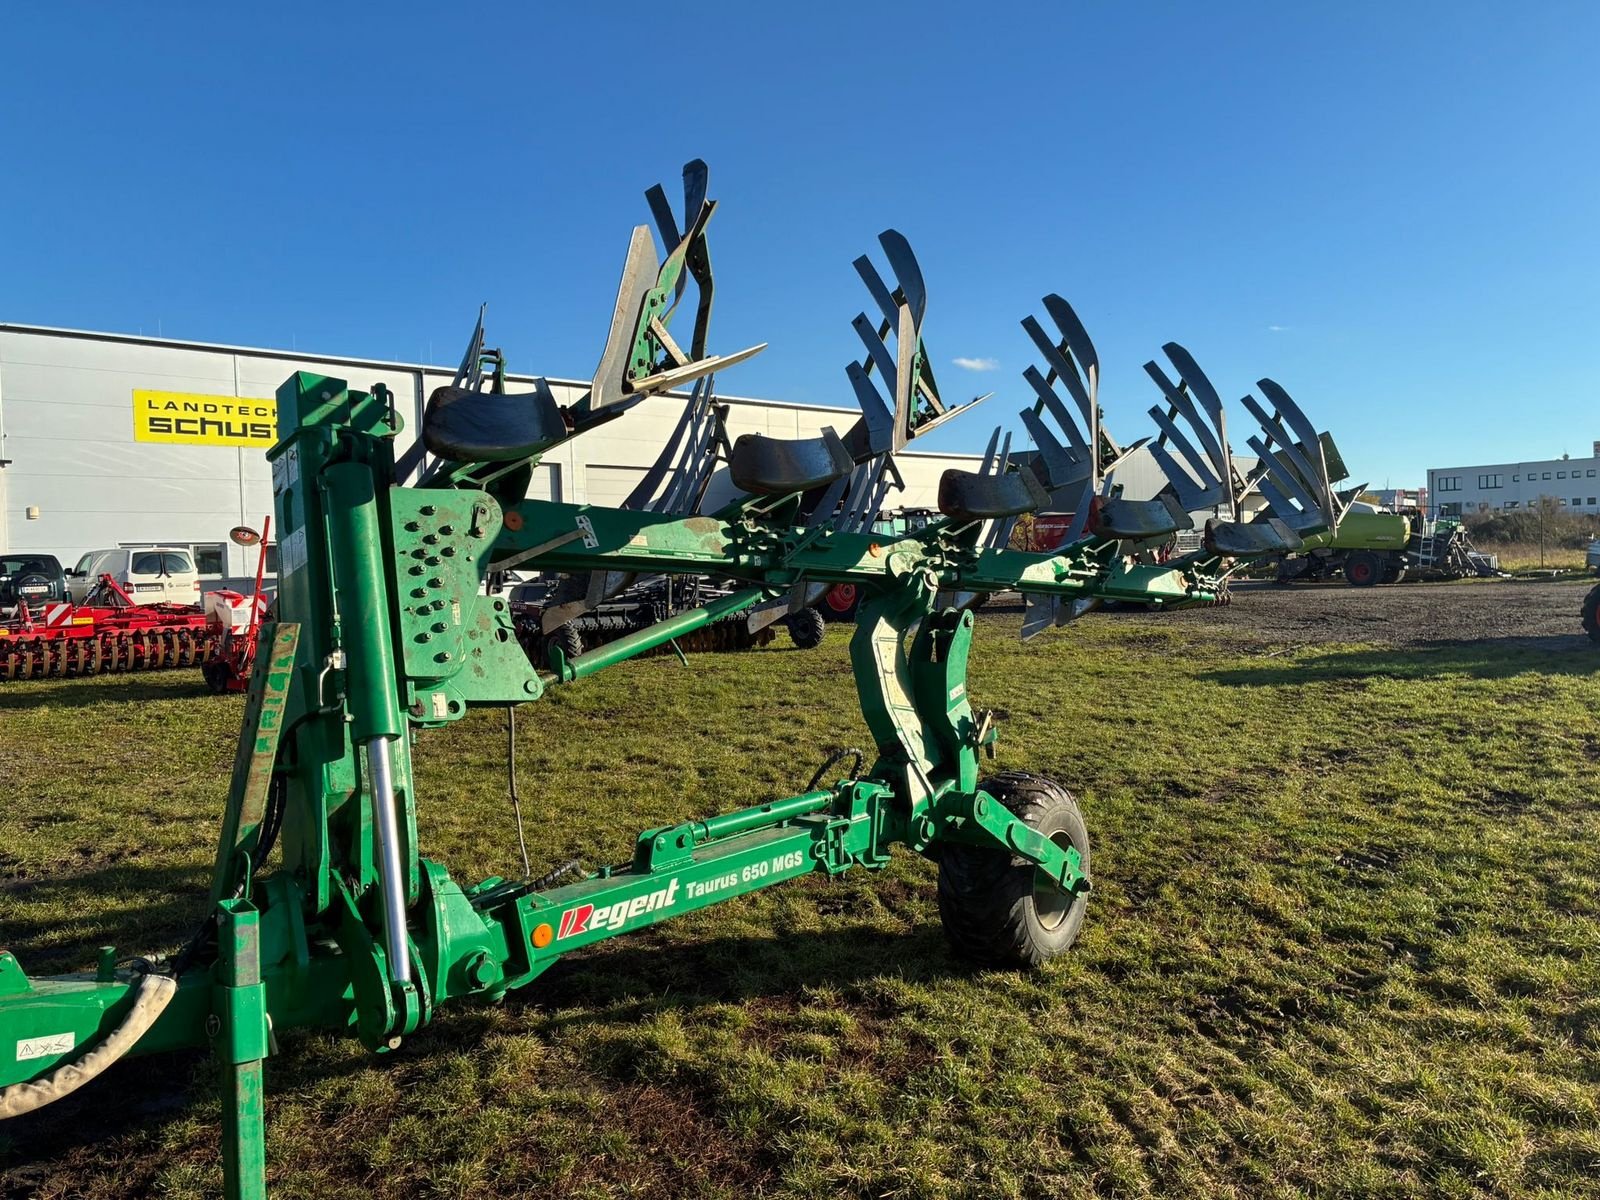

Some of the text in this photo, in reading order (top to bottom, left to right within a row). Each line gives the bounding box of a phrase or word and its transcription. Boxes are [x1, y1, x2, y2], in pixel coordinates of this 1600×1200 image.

[149, 417, 277, 439] schus
[557, 850, 803, 941] Regent Taurus 650 MGS
